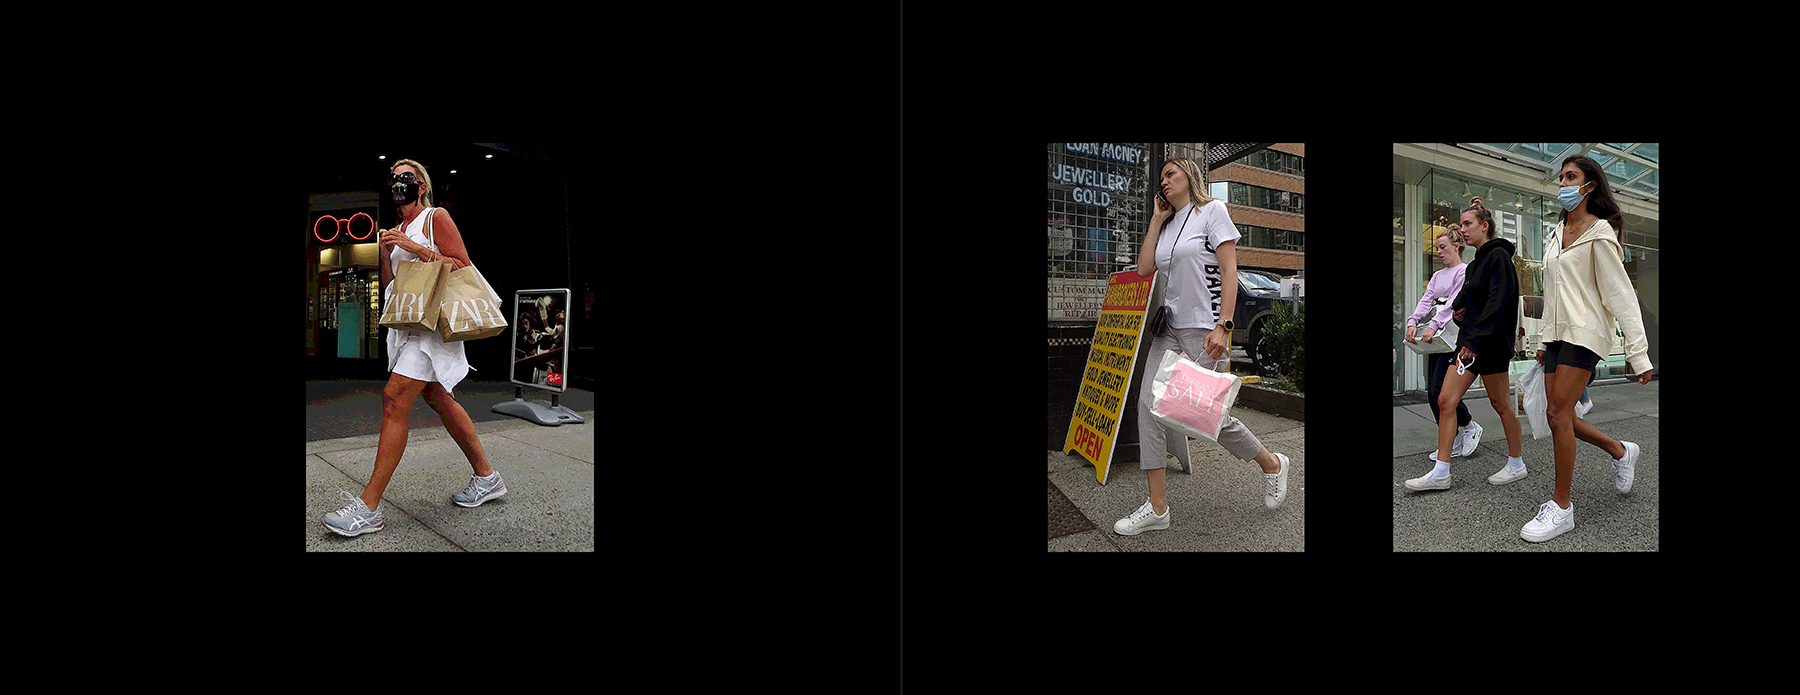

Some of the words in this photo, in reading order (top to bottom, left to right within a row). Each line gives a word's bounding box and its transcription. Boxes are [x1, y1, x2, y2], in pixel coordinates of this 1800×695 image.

[1052, 163, 1132, 193] JEWELLERY
[1072, 187, 1111, 207] GOLD
[1047, 286, 1086, 295] CUSTOM
[441, 298, 508, 332] ZARA
[1065, 310, 1097, 318] REPAIR
[1086, 366, 1099, 382] GOLD
[1097, 370, 1125, 393] JEWELLERY
[1176, 371, 1224, 395] CLEARANCE
[1103, 393, 1120, 414] MORE
[1167, 379, 1220, 416] SALE
[1074, 424, 1104, 462] OPEN
